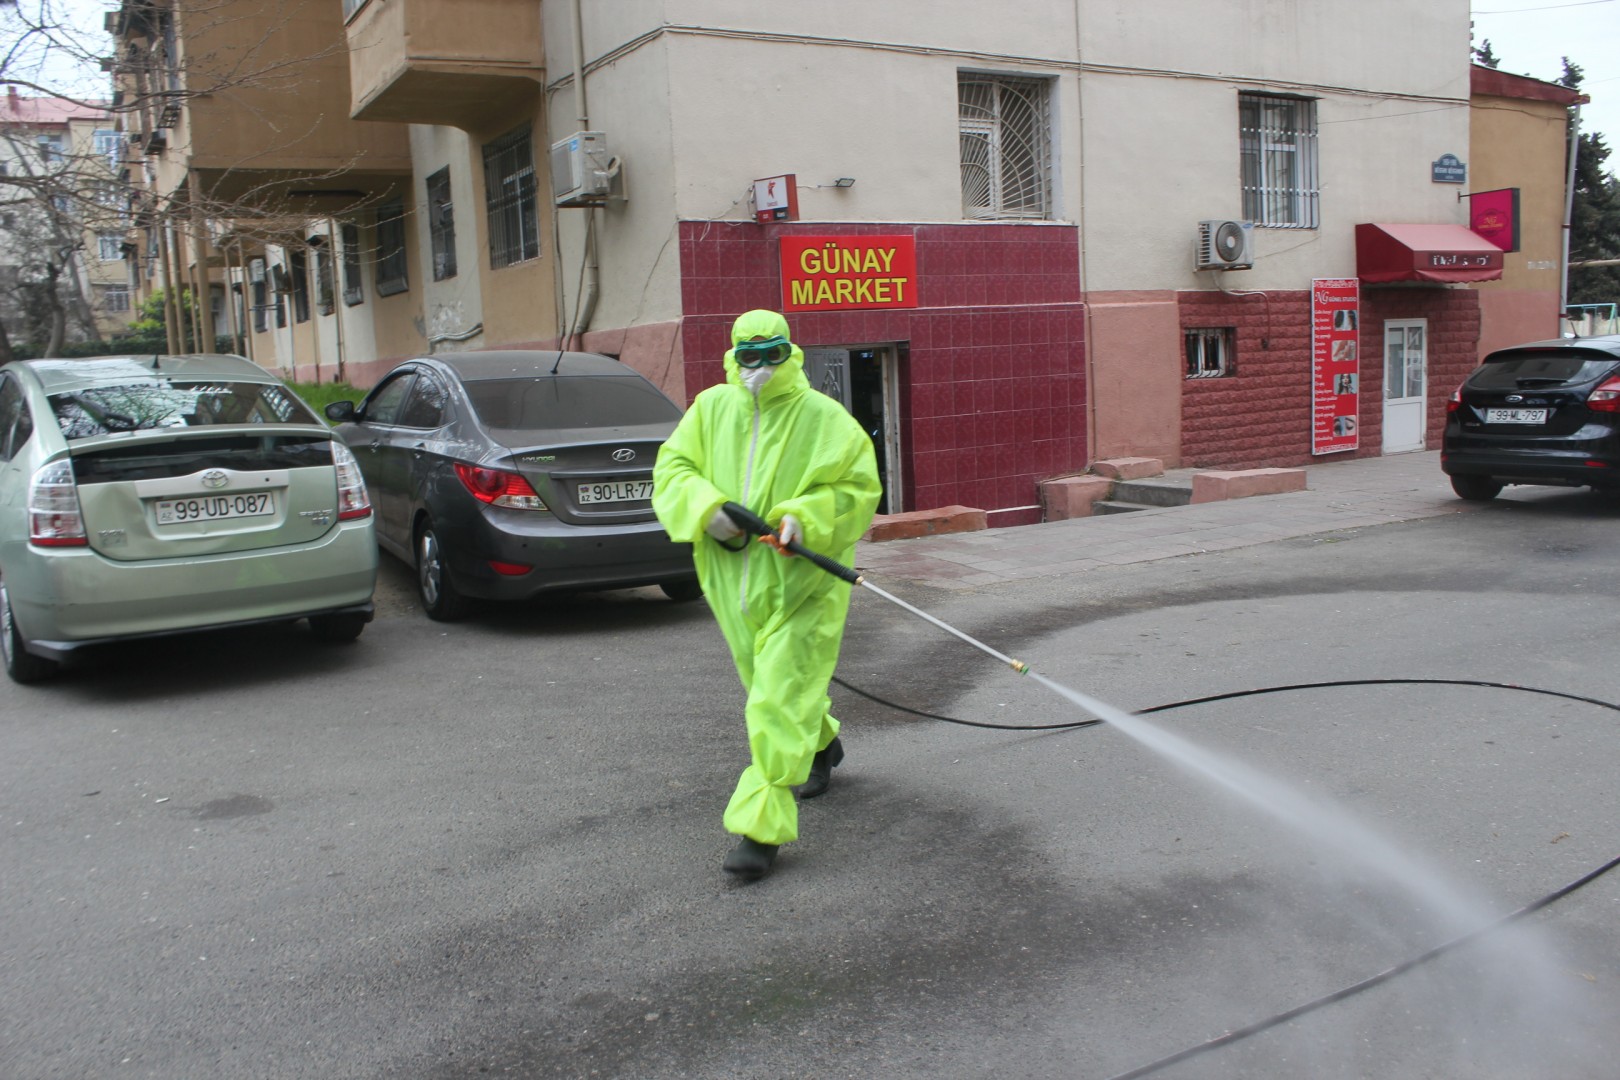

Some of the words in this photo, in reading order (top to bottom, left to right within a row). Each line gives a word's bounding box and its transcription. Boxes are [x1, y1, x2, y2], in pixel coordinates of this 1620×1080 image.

[800, 242, 896, 274] GÜNAY
[791, 278, 907, 305] MARKET
[593, 481, 654, 501] 90-LR-77
[175, 494, 268, 520] 99-UD-087
